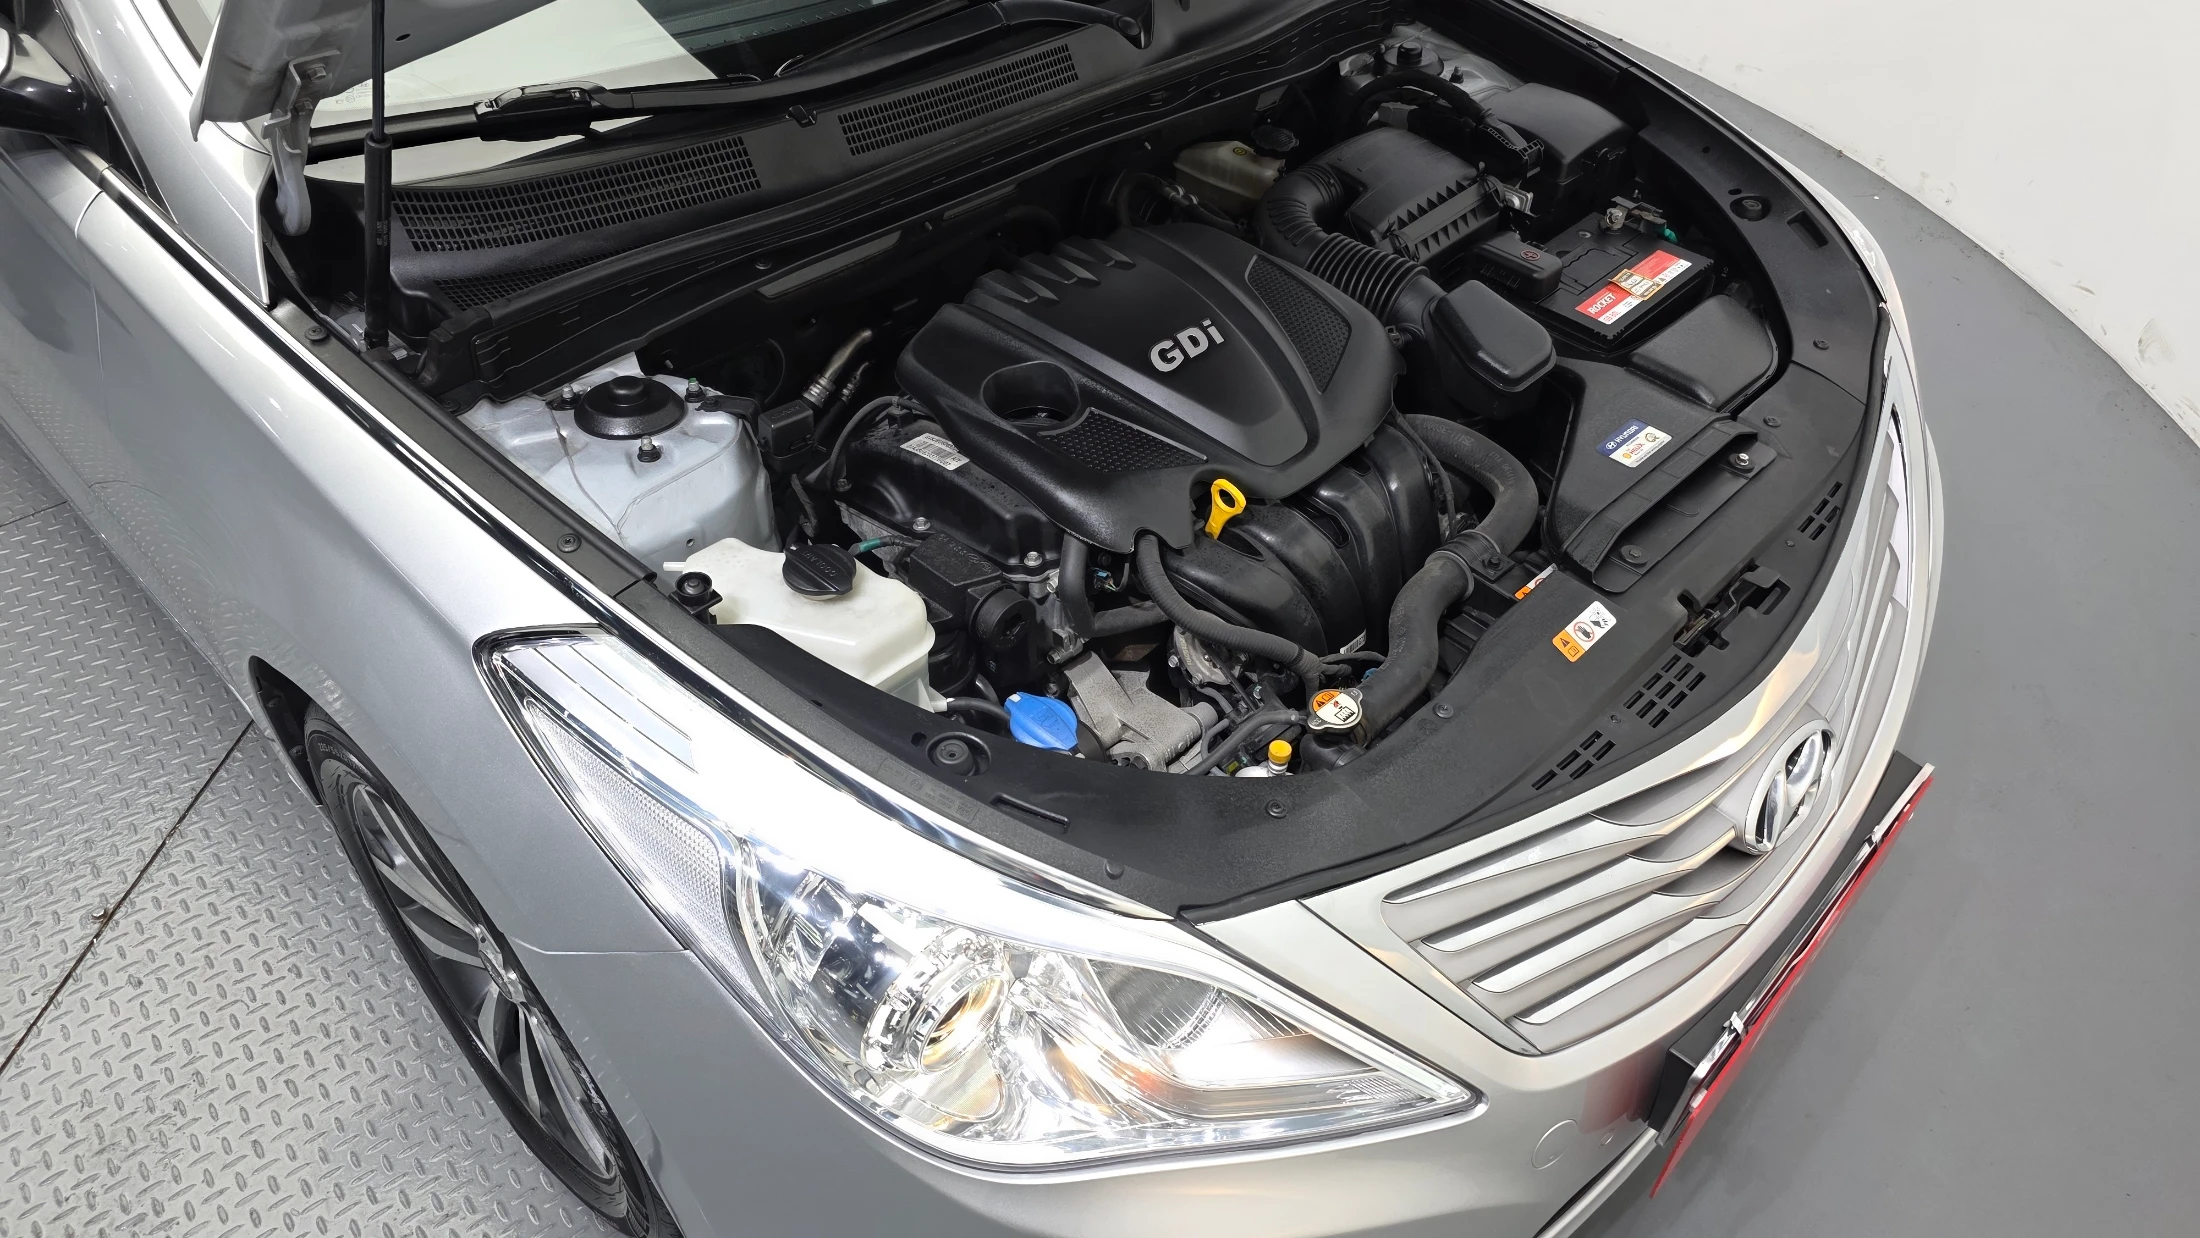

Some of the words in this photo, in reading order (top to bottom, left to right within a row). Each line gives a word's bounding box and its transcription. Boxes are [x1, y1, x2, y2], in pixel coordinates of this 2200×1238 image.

[1587, 292, 1616, 315] ROCKET
[1148, 318, 1225, 372] GDi
[1614, 425, 1639, 443] HYUNDAI
[802, 550, 838, 577] COOLANT
